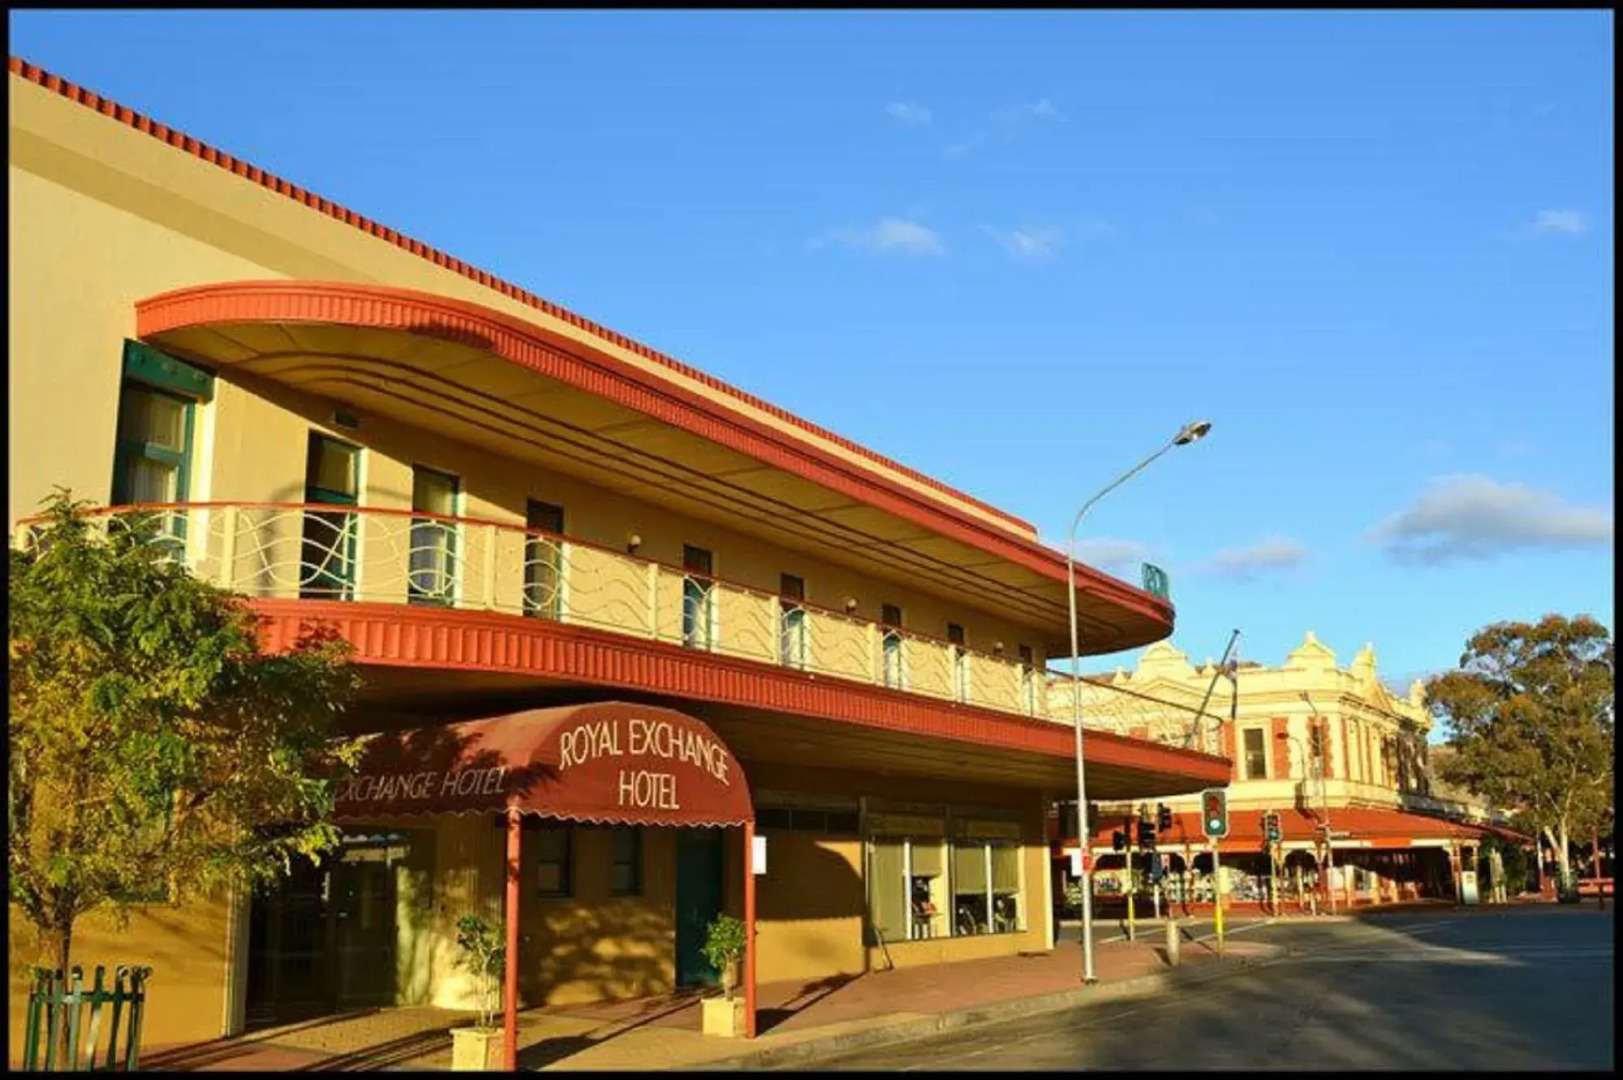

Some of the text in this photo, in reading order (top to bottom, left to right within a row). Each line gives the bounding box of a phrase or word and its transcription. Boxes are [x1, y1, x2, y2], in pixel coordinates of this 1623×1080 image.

[559, 719, 730, 786] ROYAL EXCHANGE
[440, 767, 504, 796] HOTEL
[619, 769, 680, 810] HOTEL
